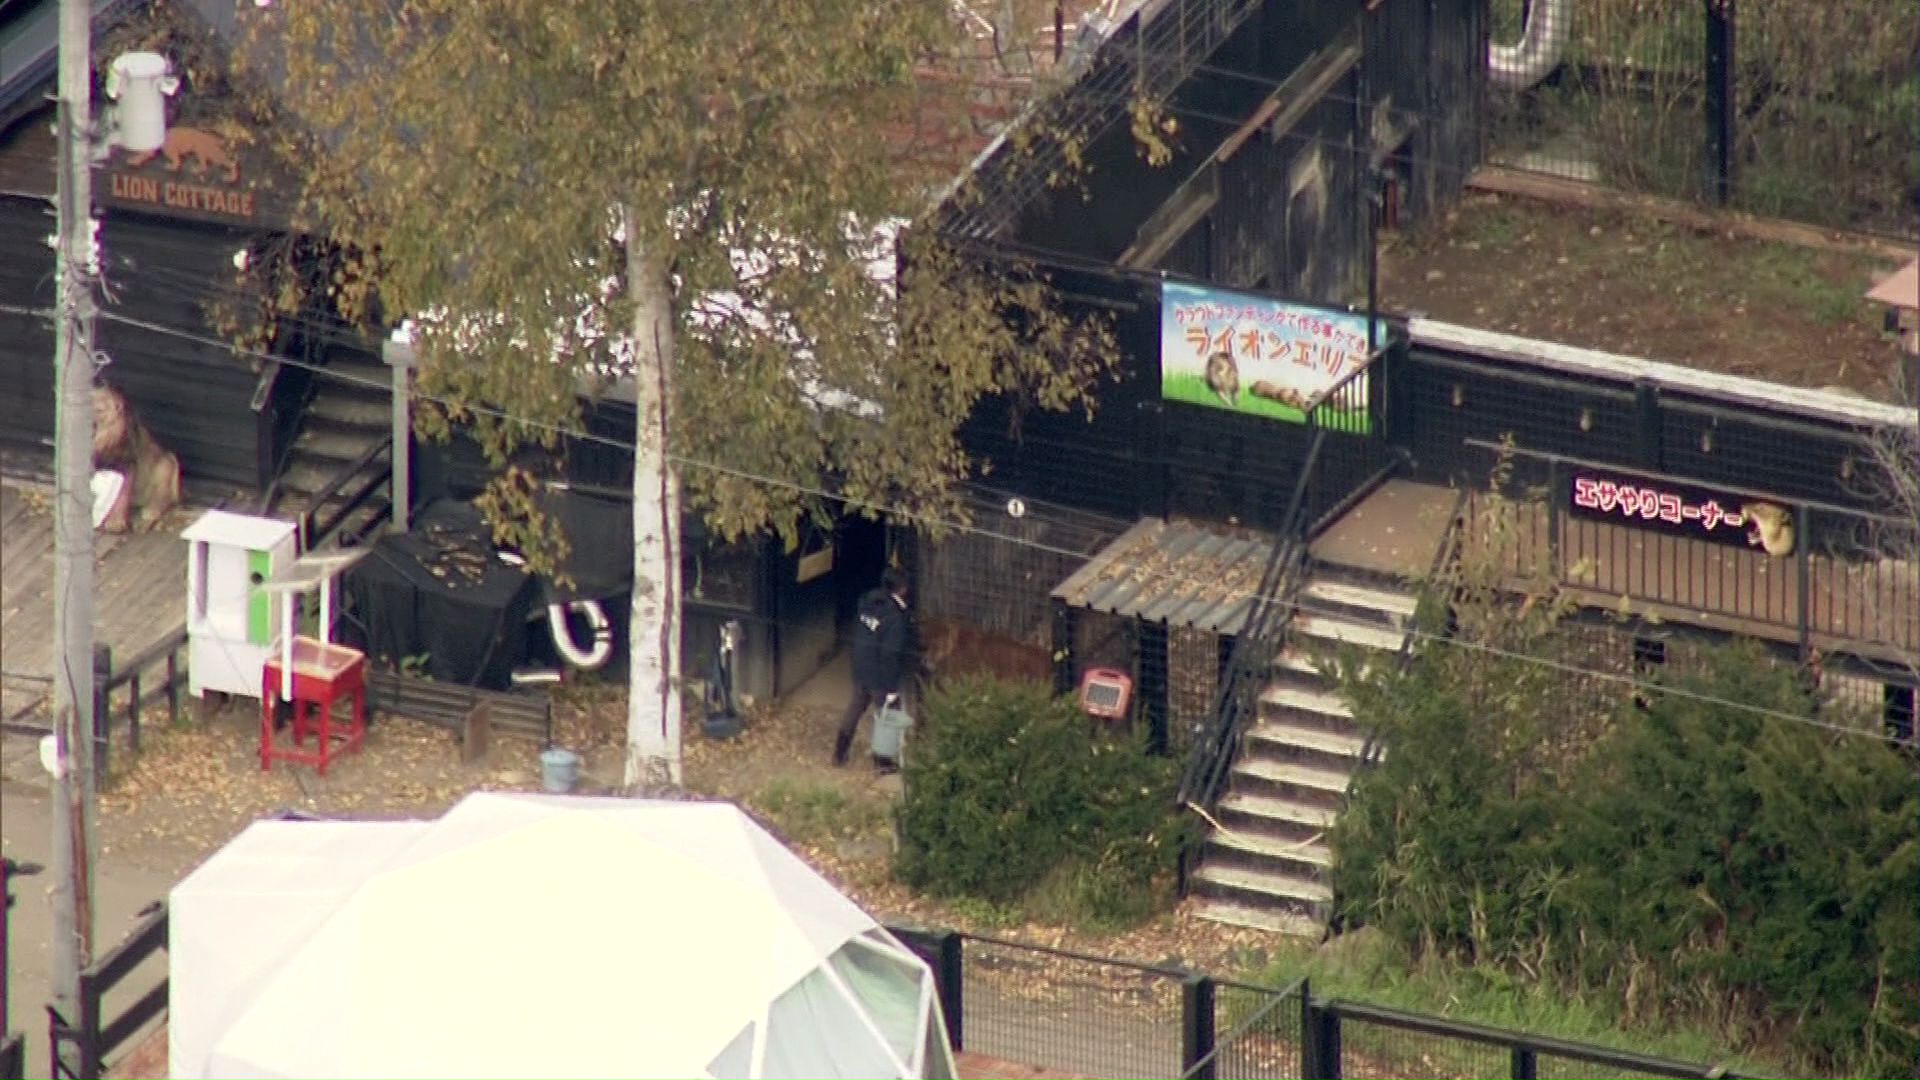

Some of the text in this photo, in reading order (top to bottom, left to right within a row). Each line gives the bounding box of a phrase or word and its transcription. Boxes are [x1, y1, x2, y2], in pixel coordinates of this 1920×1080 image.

[112, 173, 254, 217] LION COTTAGE
[1575, 478, 1744, 530] エサやりコーナー
